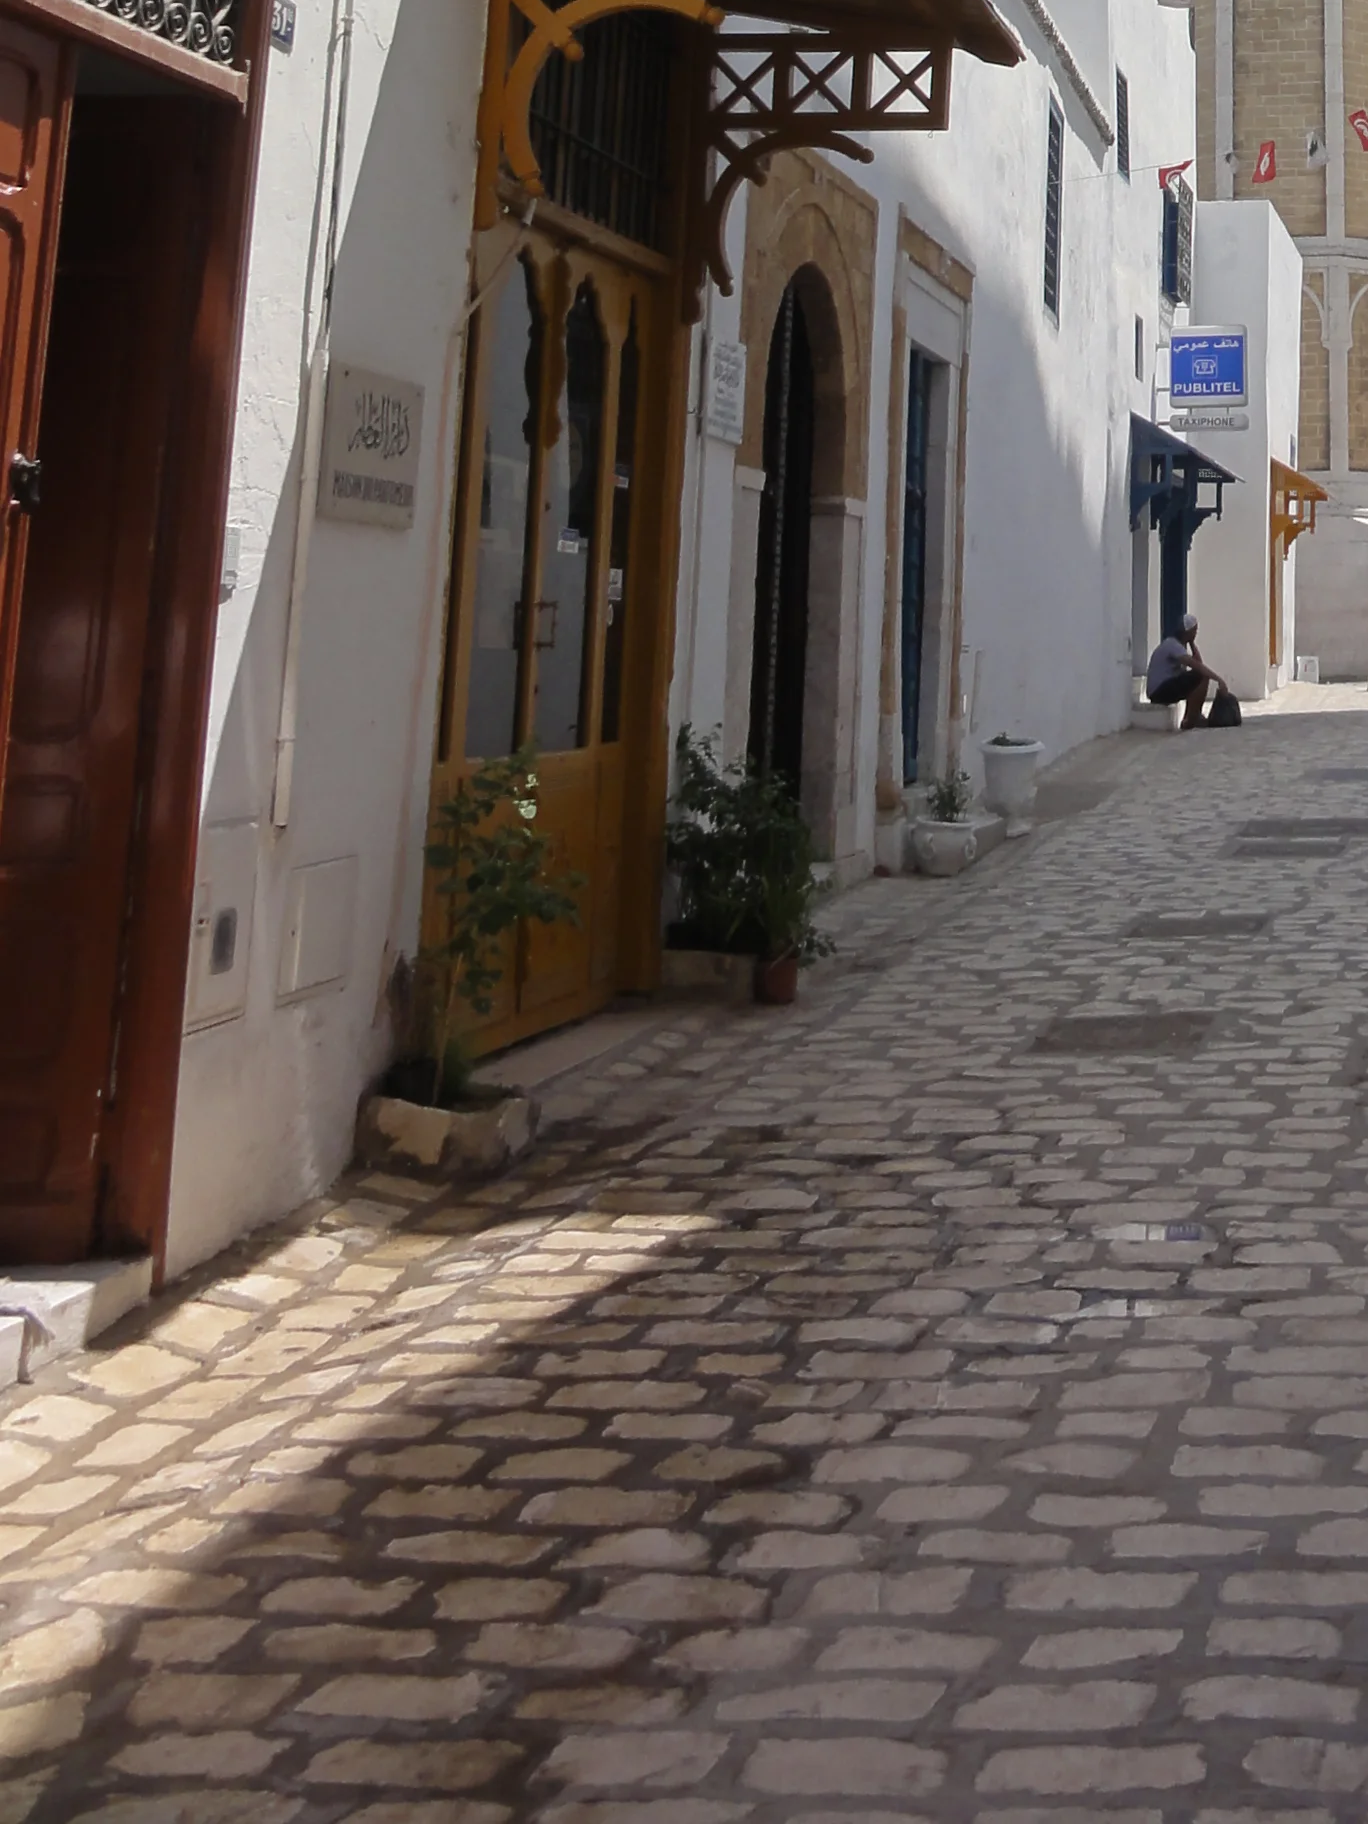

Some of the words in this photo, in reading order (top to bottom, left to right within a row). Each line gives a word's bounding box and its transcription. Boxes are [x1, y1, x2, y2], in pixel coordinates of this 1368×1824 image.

[1173, 340, 1209, 353] عمومي
[1213, 338, 1239, 348] هاتف
[1173, 381, 1241, 394] PUBLITEL
[1178, 418, 1235, 427] TAXIPHONE
